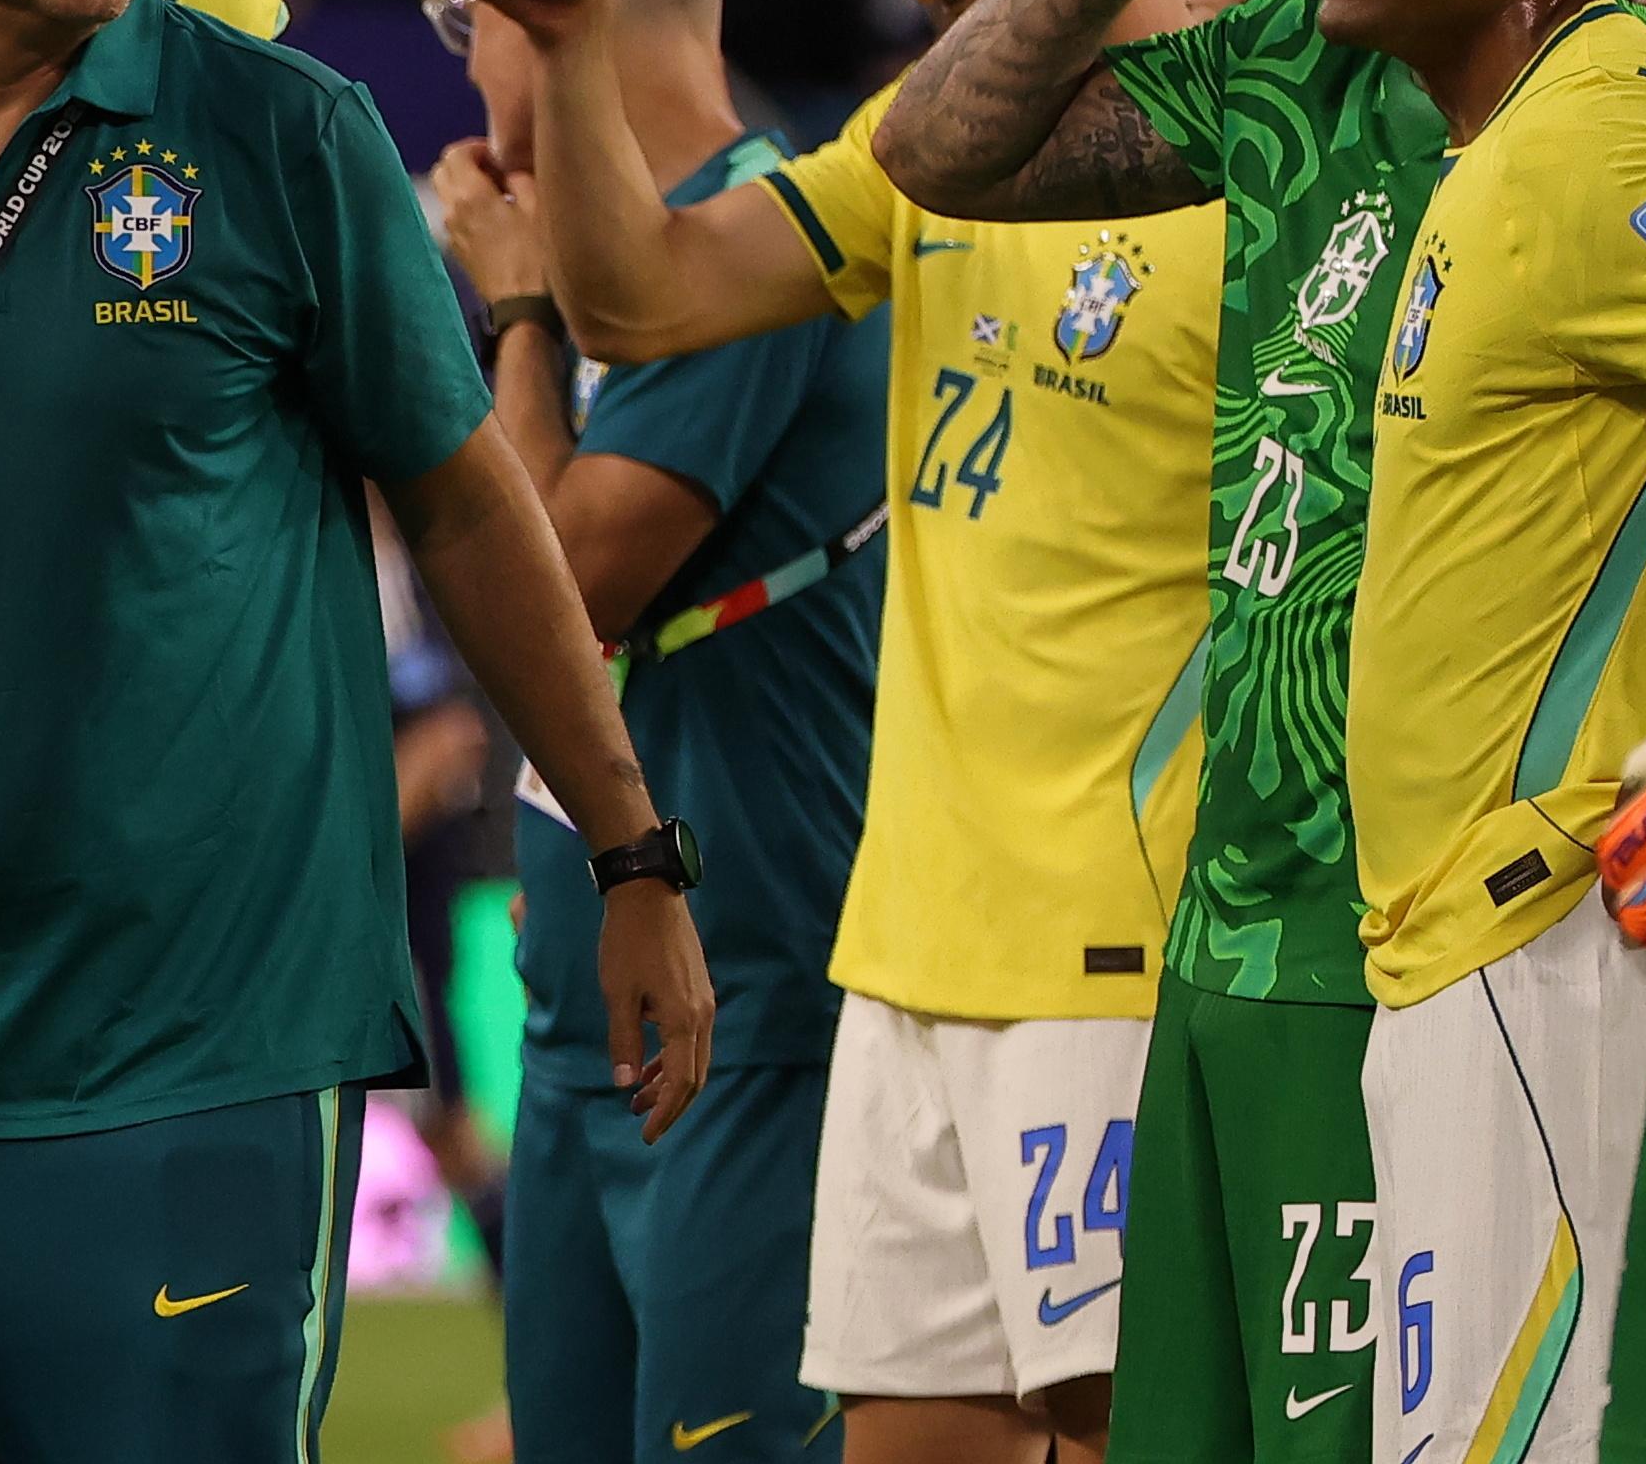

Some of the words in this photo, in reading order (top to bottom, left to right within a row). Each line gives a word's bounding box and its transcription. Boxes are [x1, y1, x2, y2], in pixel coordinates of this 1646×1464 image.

[18, 154, 49, 195] CUP
[121, 215, 162, 232] CBF
[93, 300, 198, 325] BRASIL
[1032, 363, 1110, 407] BRASIL
[1381, 392, 1427, 421] BRASIL
[910, 367, 1013, 521] 24
[1222, 435, 1305, 598] 23
[1021, 1119, 1134, 1271] 24
[1281, 1201, 1379, 1354] 23
[1398, 1250, 1434, 1416] 6
